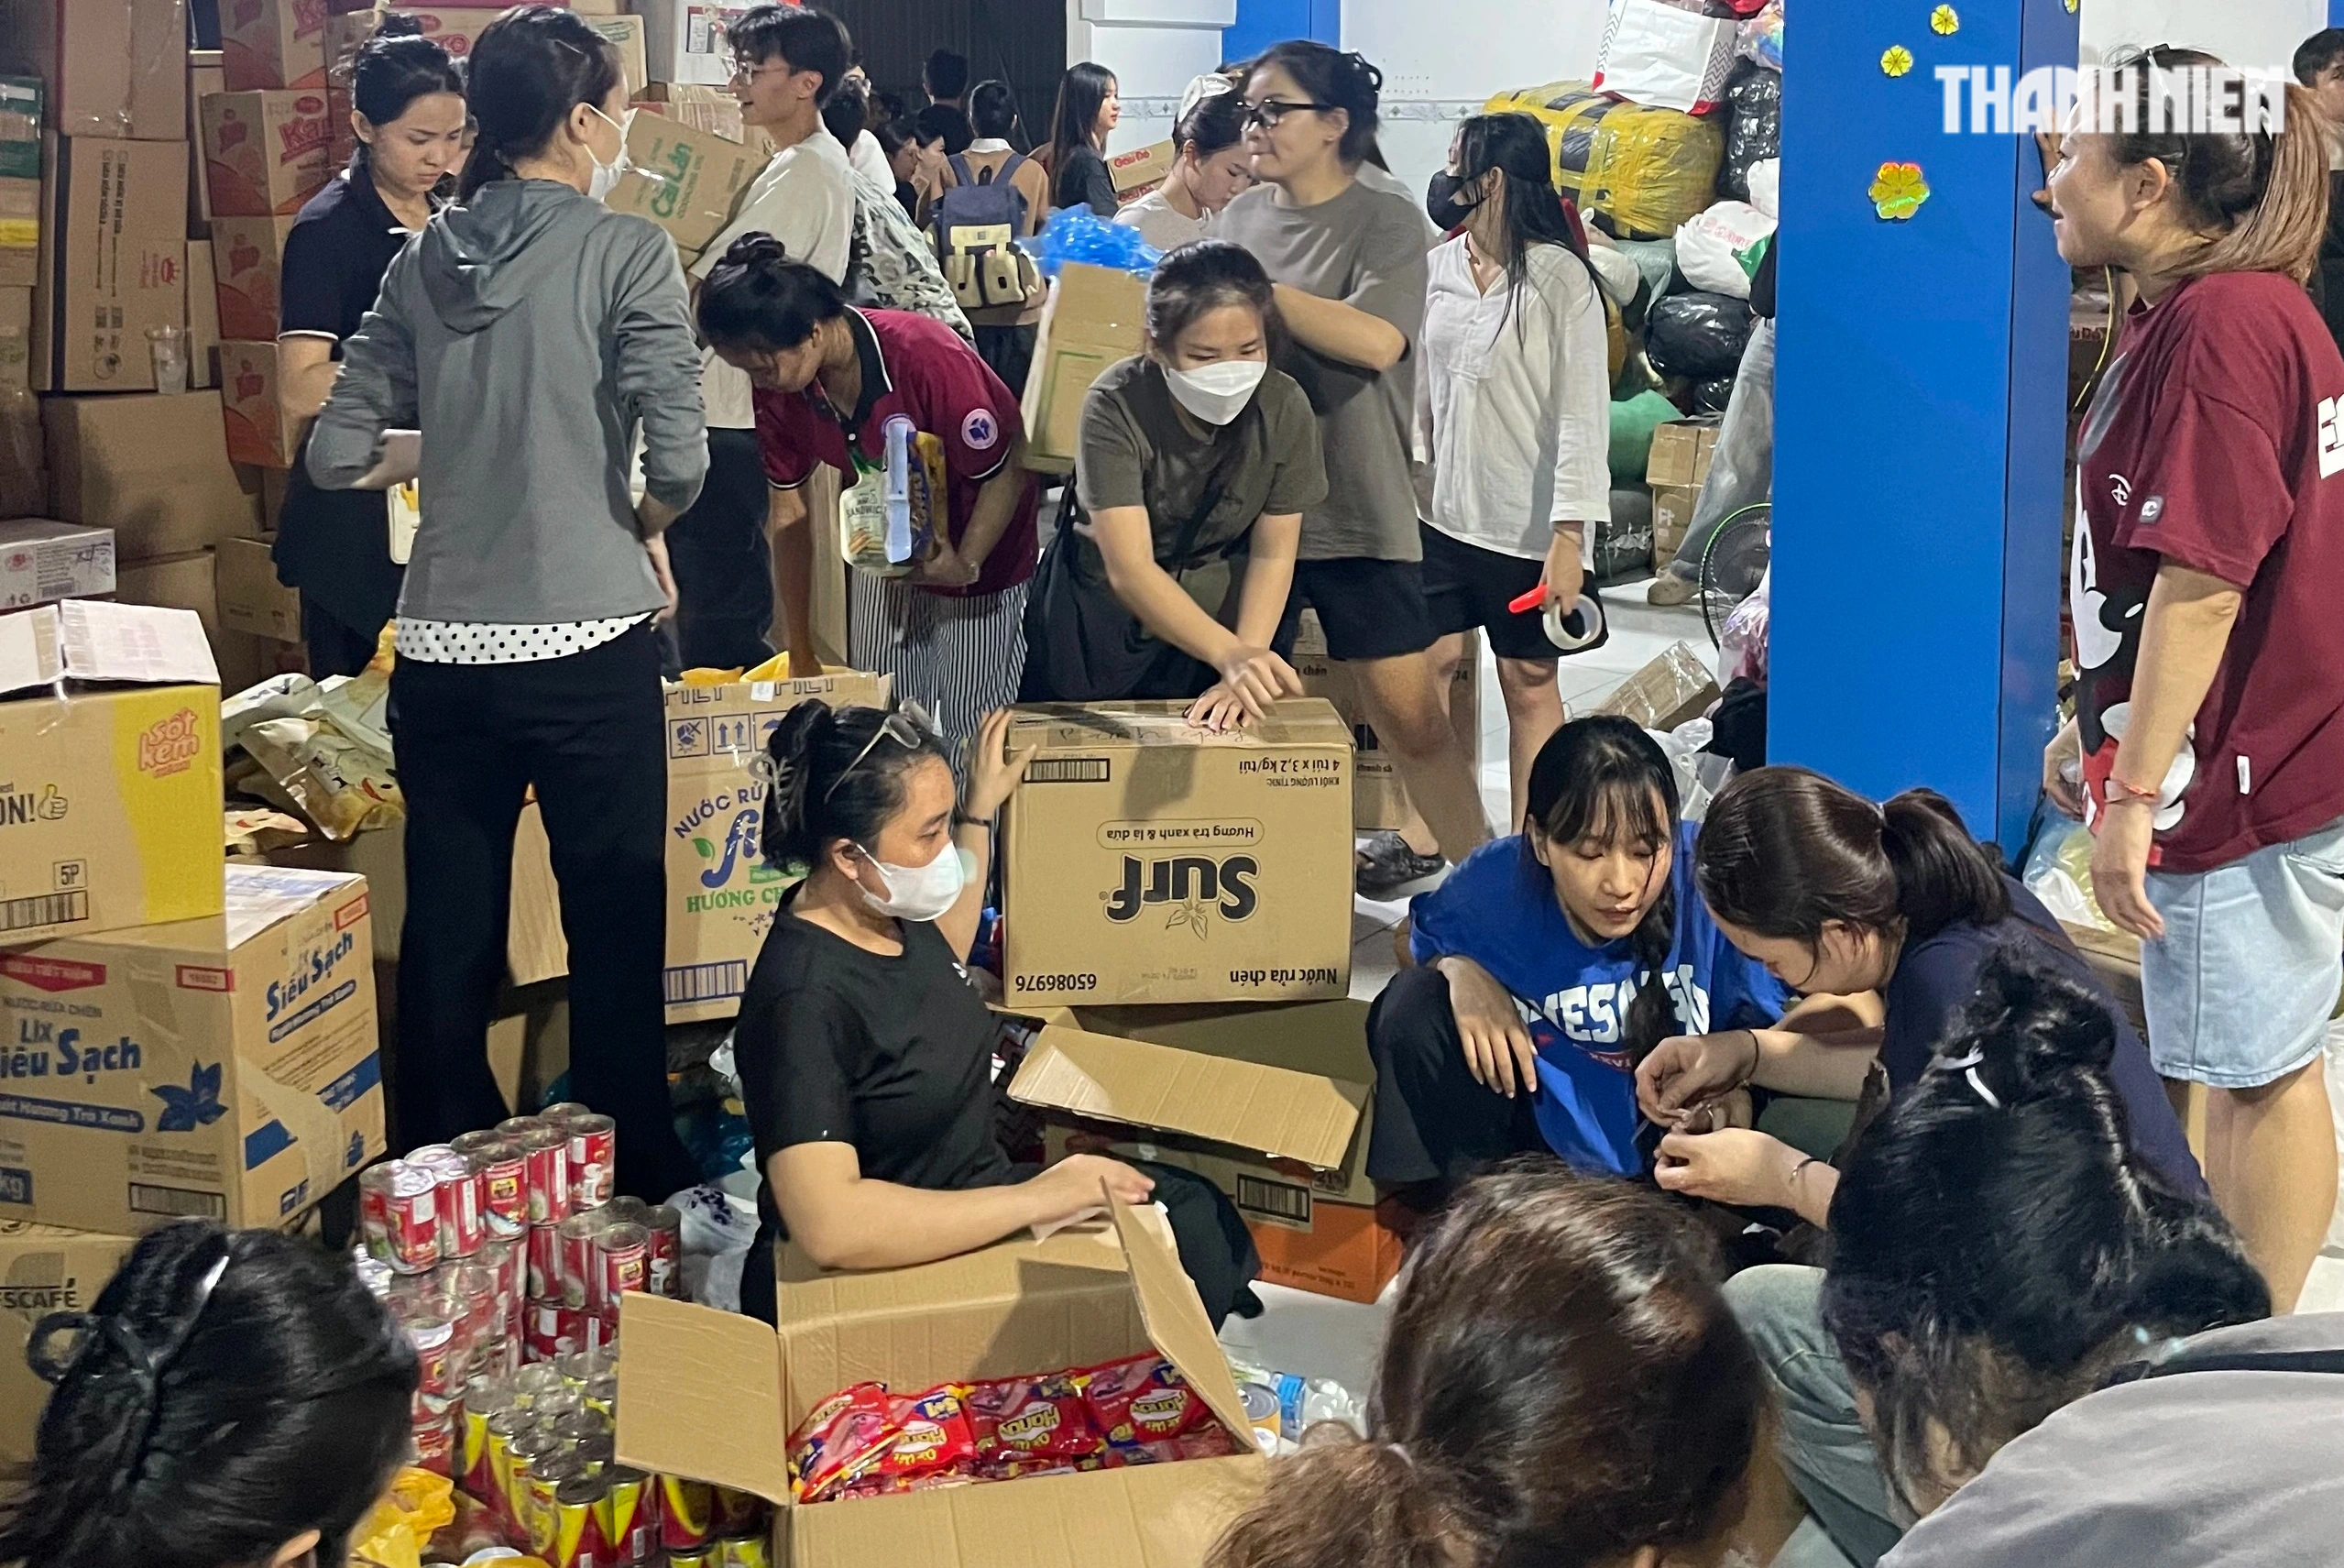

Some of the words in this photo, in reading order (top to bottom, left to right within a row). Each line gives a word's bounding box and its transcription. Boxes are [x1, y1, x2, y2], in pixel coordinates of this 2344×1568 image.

[1332, 759, 1340, 771] 4
[0, 793, 36, 825] N!
[674, 795, 731, 839] NƯỚC
[737, 781, 763, 804] RỬ
[1146, 828, 1156, 839] &
[1158, 828, 1190, 841] xanh
[1106, 856, 1258, 921] Surf
[686, 888, 756, 914] HƯƠNG
[311, 930, 354, 984] Sạch
[1014, 973, 1098, 992] 65086976
[1230, 970, 1266, 987] chén
[1269, 969, 1296, 987] rửa
[1297, 968, 1338, 985] Nước
[0, 1046, 49, 1079] iêu
[56, 1027, 141, 1084] Sạch
[0, 1277, 82, 1309] SCAFÉ
